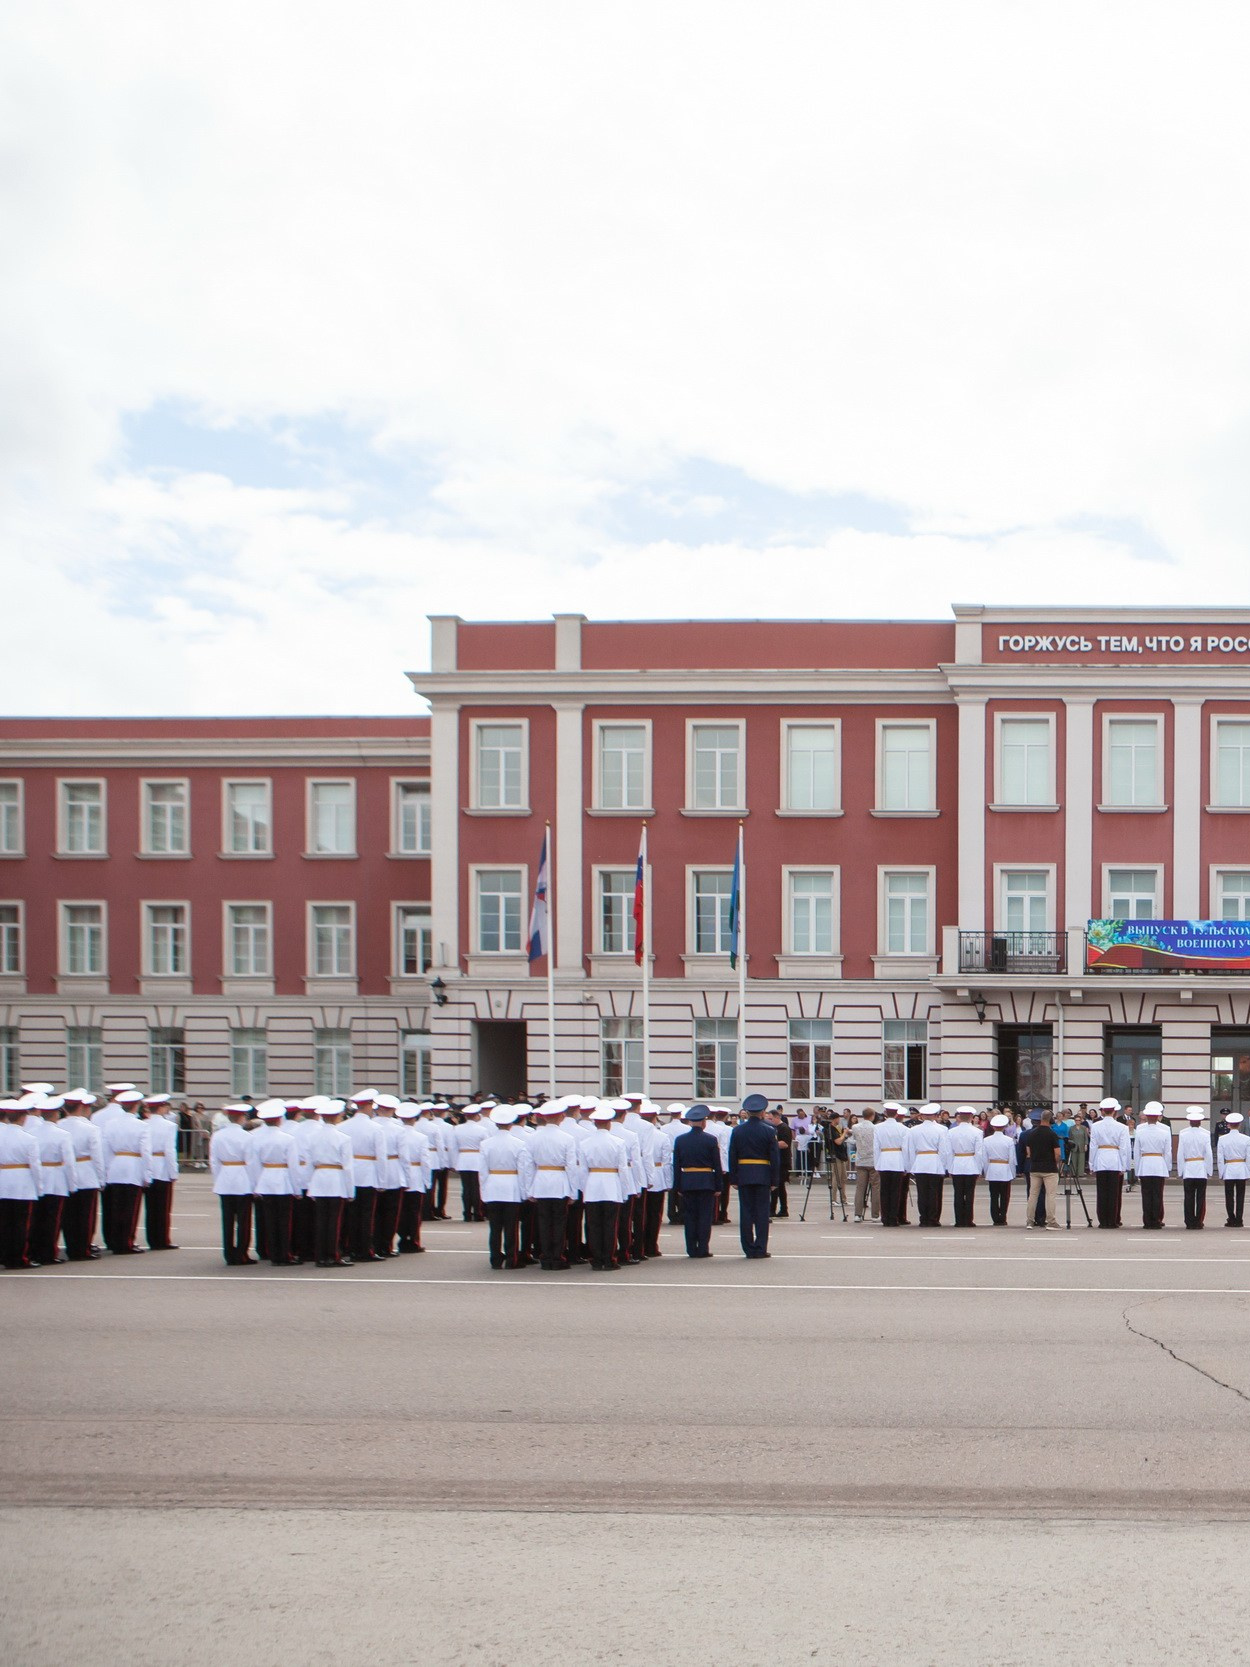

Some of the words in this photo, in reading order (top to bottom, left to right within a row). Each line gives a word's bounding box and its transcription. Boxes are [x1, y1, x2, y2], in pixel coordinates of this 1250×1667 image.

[998, 635, 1092, 652] ГОРЖУСЬ
[1189, 636, 1202, 652] Я
[1127, 925, 1178, 935] ВЫПУСК
[1181, 926, 1188, 935] В
[1177, 939, 1235, 949] ВОЕННОМ
